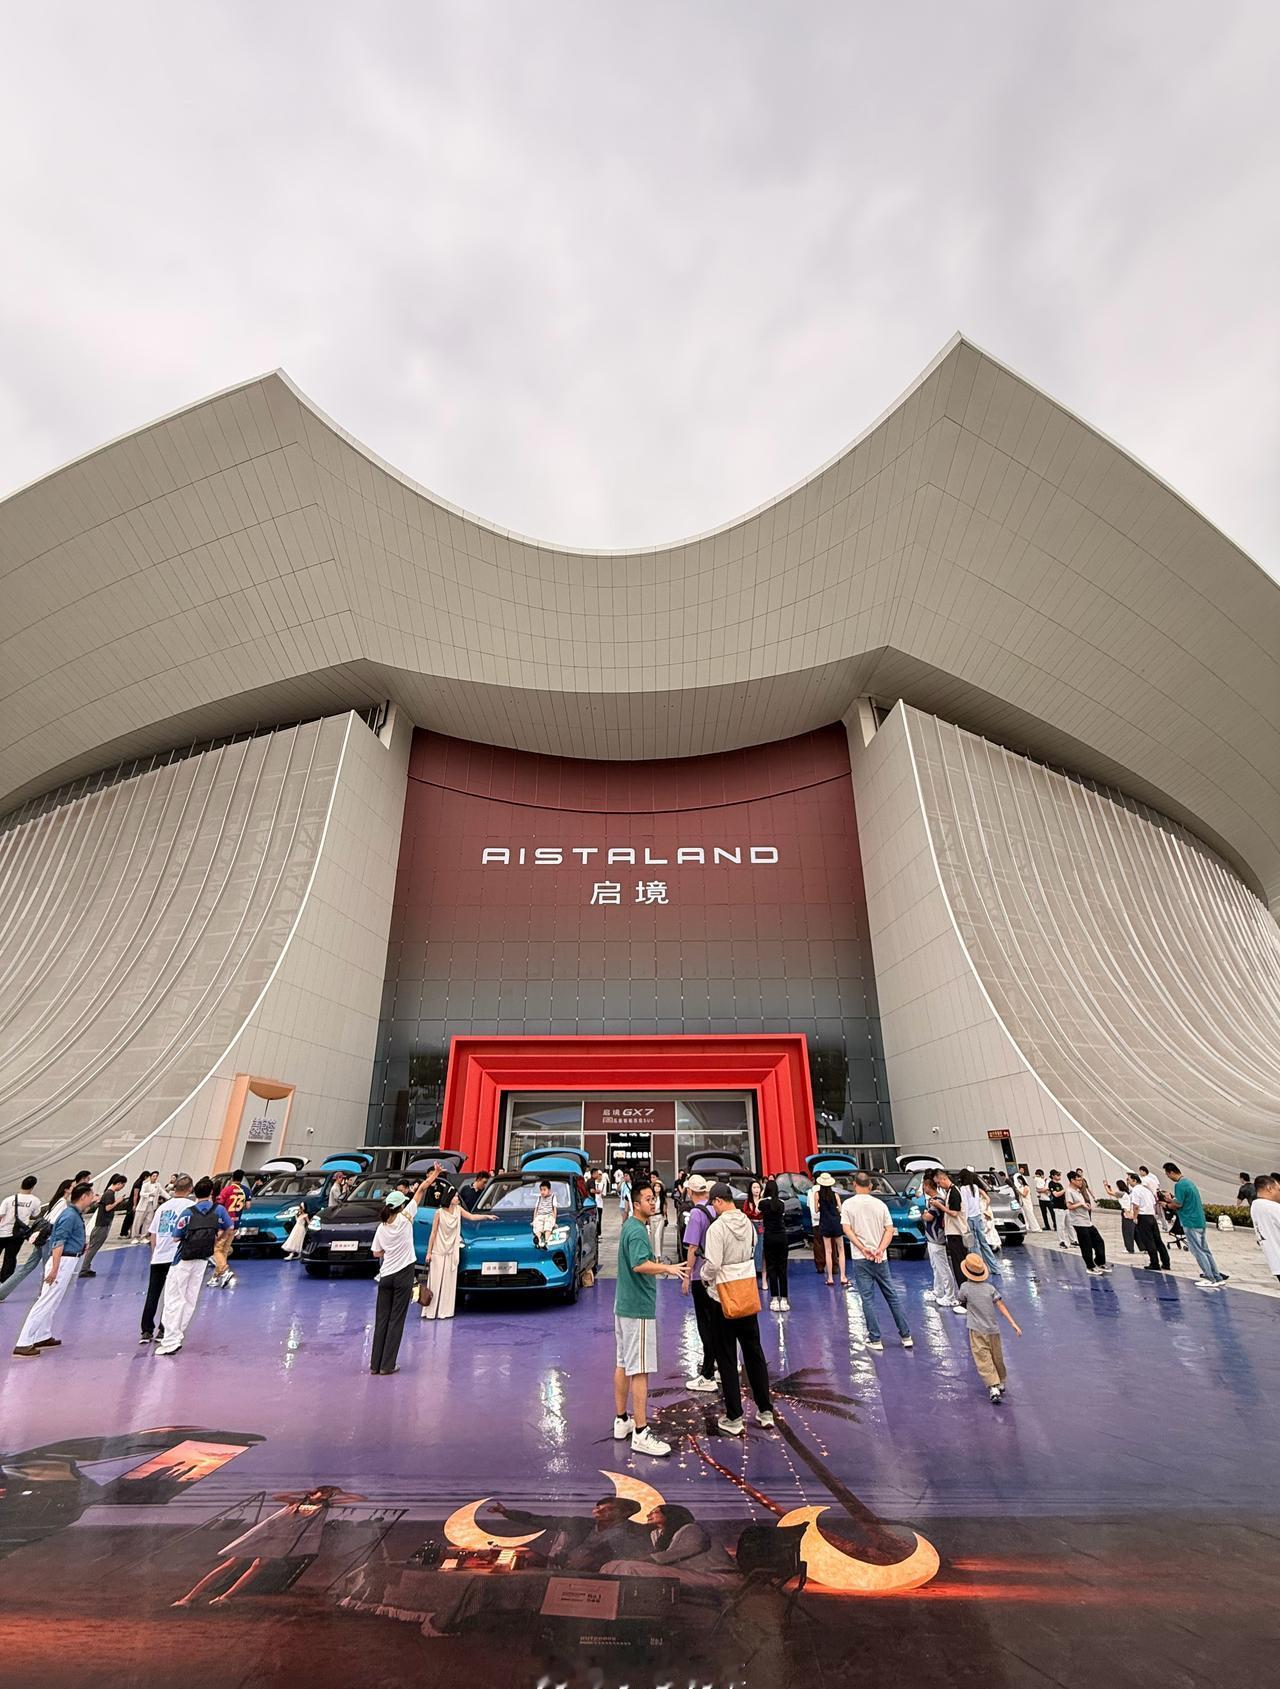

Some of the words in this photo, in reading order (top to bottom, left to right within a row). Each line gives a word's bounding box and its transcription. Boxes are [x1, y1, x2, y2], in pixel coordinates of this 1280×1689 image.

[481, 847, 779, 865] AISTALAND
[590, 880, 670, 905] 启境
[622, 1108, 655, 1116] GX7
